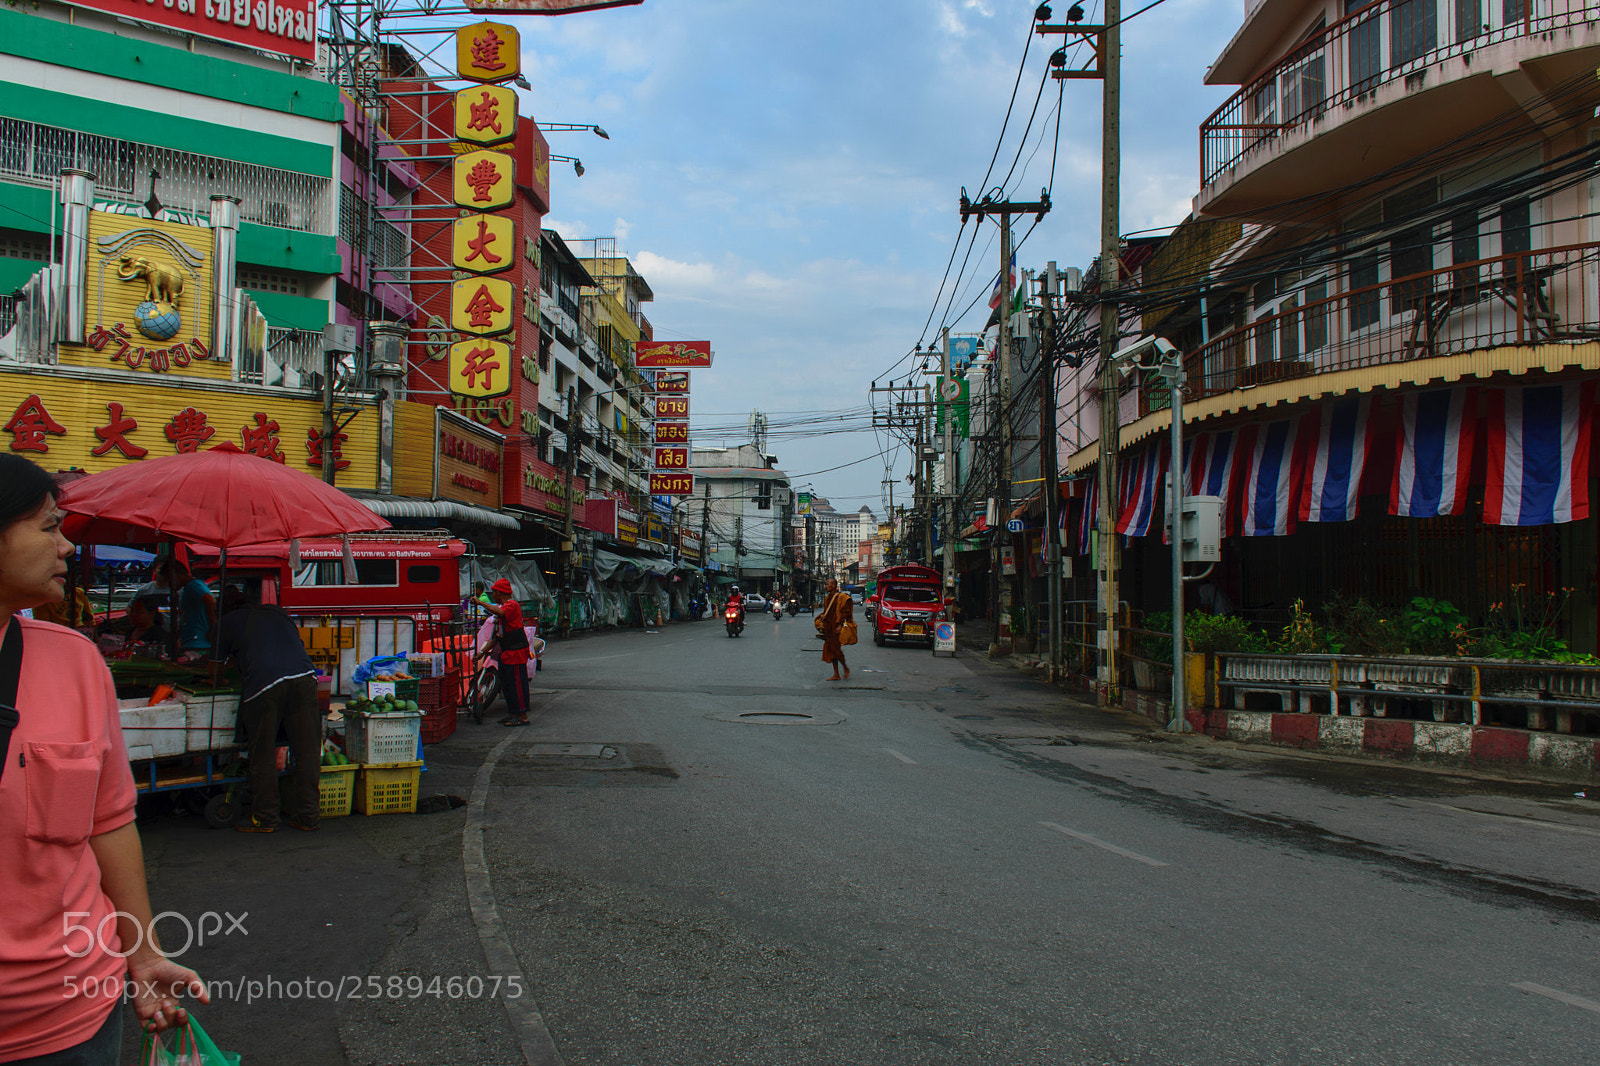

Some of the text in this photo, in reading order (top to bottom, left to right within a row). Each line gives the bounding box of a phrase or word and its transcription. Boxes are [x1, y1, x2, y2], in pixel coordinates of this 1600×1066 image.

[658, 401, 687, 413] ขาย
[657, 427, 687, 438] ทอง
[658, 448, 684, 466] เสือ
[652, 474, 692, 491] มังกร
[1009, 520, 1022, 531] ยา
